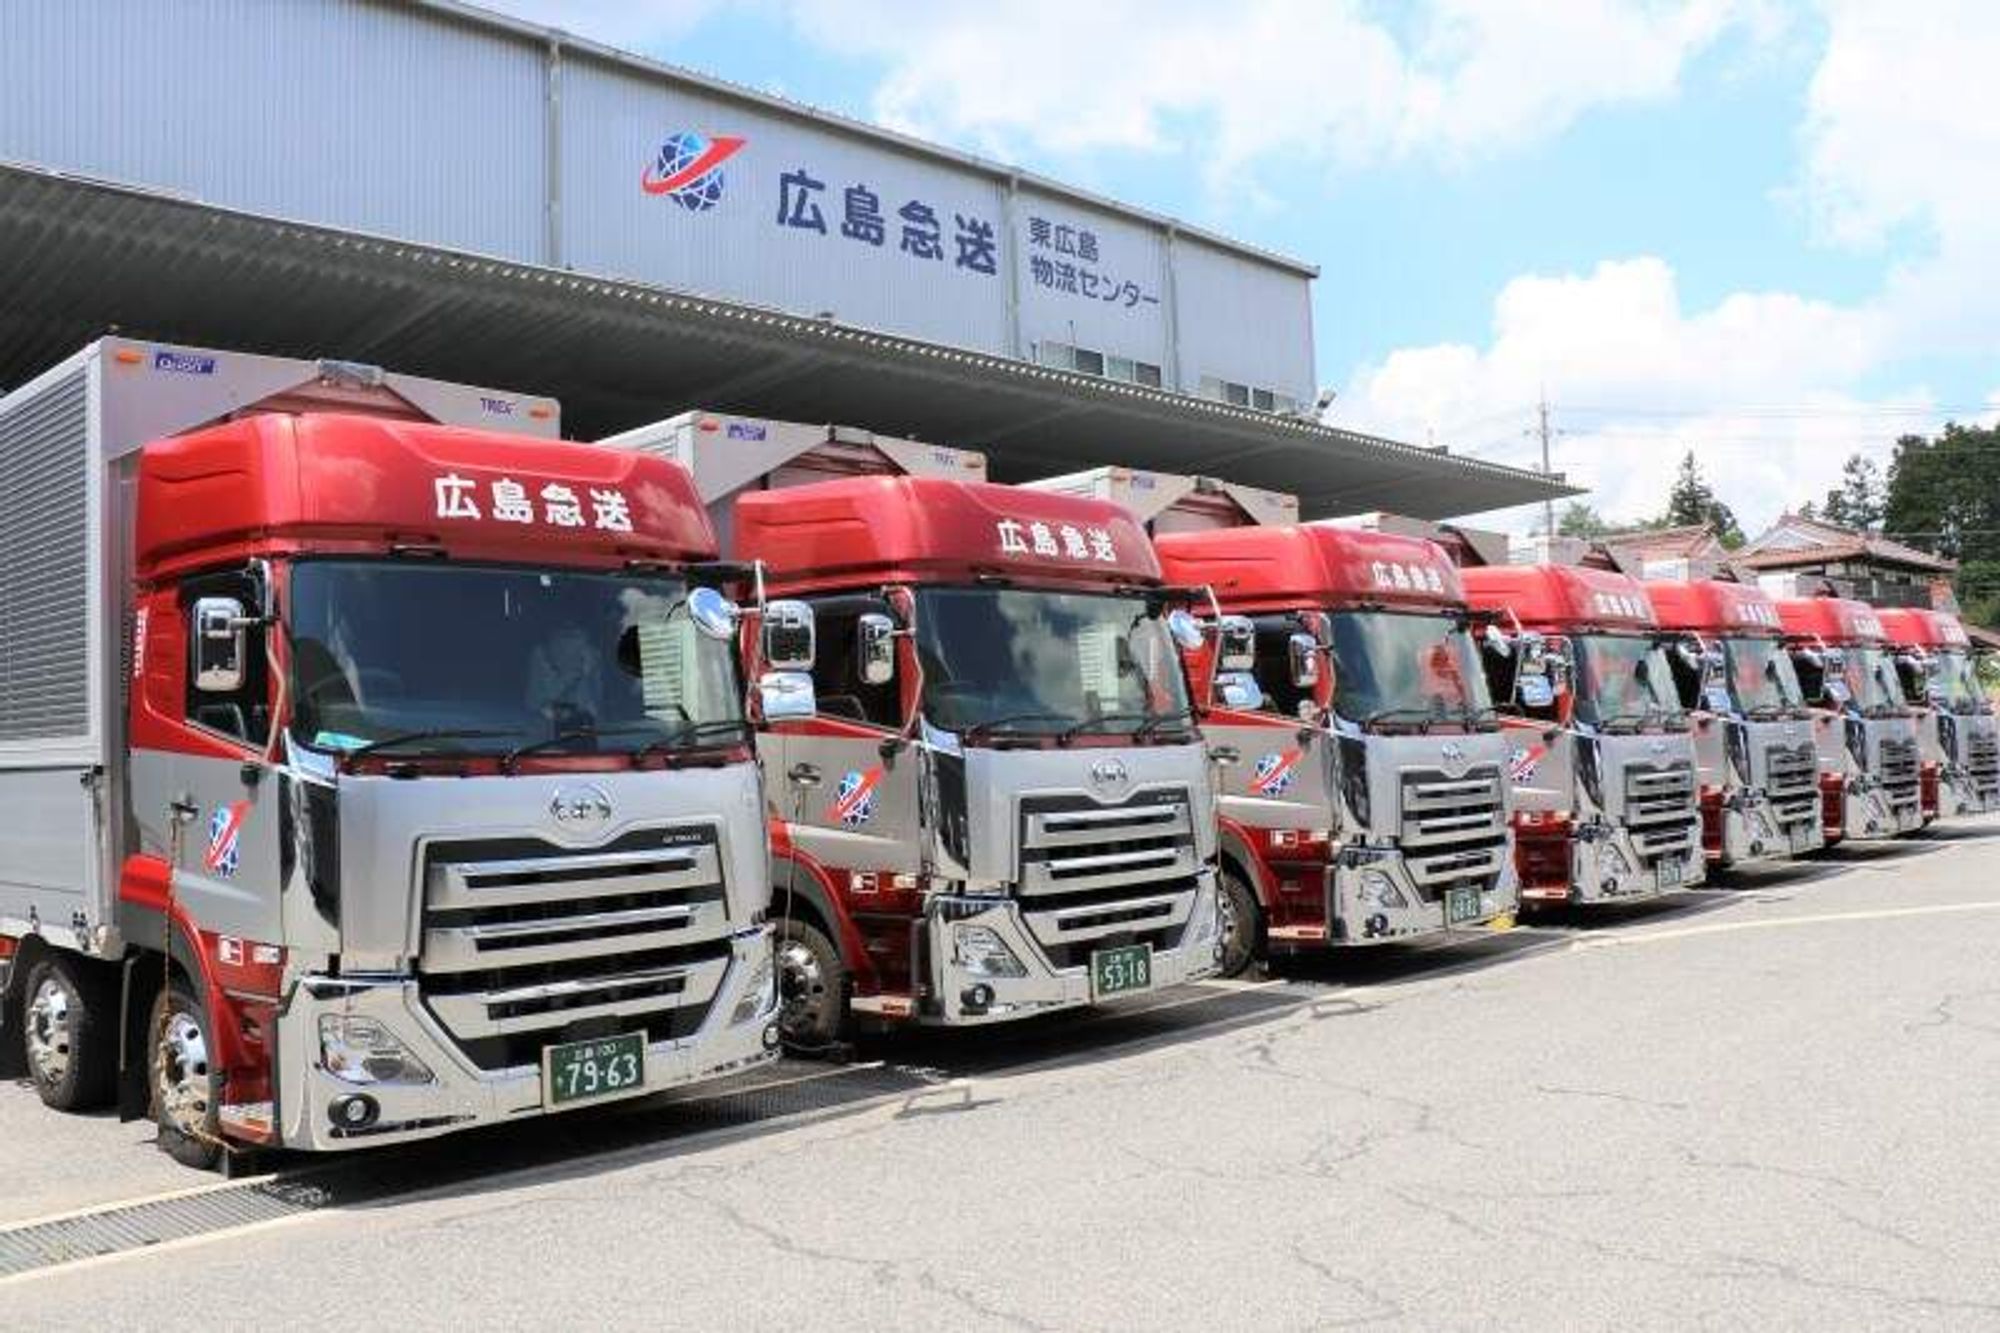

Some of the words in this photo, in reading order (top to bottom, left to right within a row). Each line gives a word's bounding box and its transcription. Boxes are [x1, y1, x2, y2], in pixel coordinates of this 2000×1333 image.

[777, 169, 998, 276] 広島急送
[1028, 217, 1099, 262] 東広島
[1030, 255, 1160, 307] 物流センター
[434, 473, 634, 532] 広島急送
[996, 519, 1117, 562] 広島急送
[565, 1054, 638, 1095] 79-63
